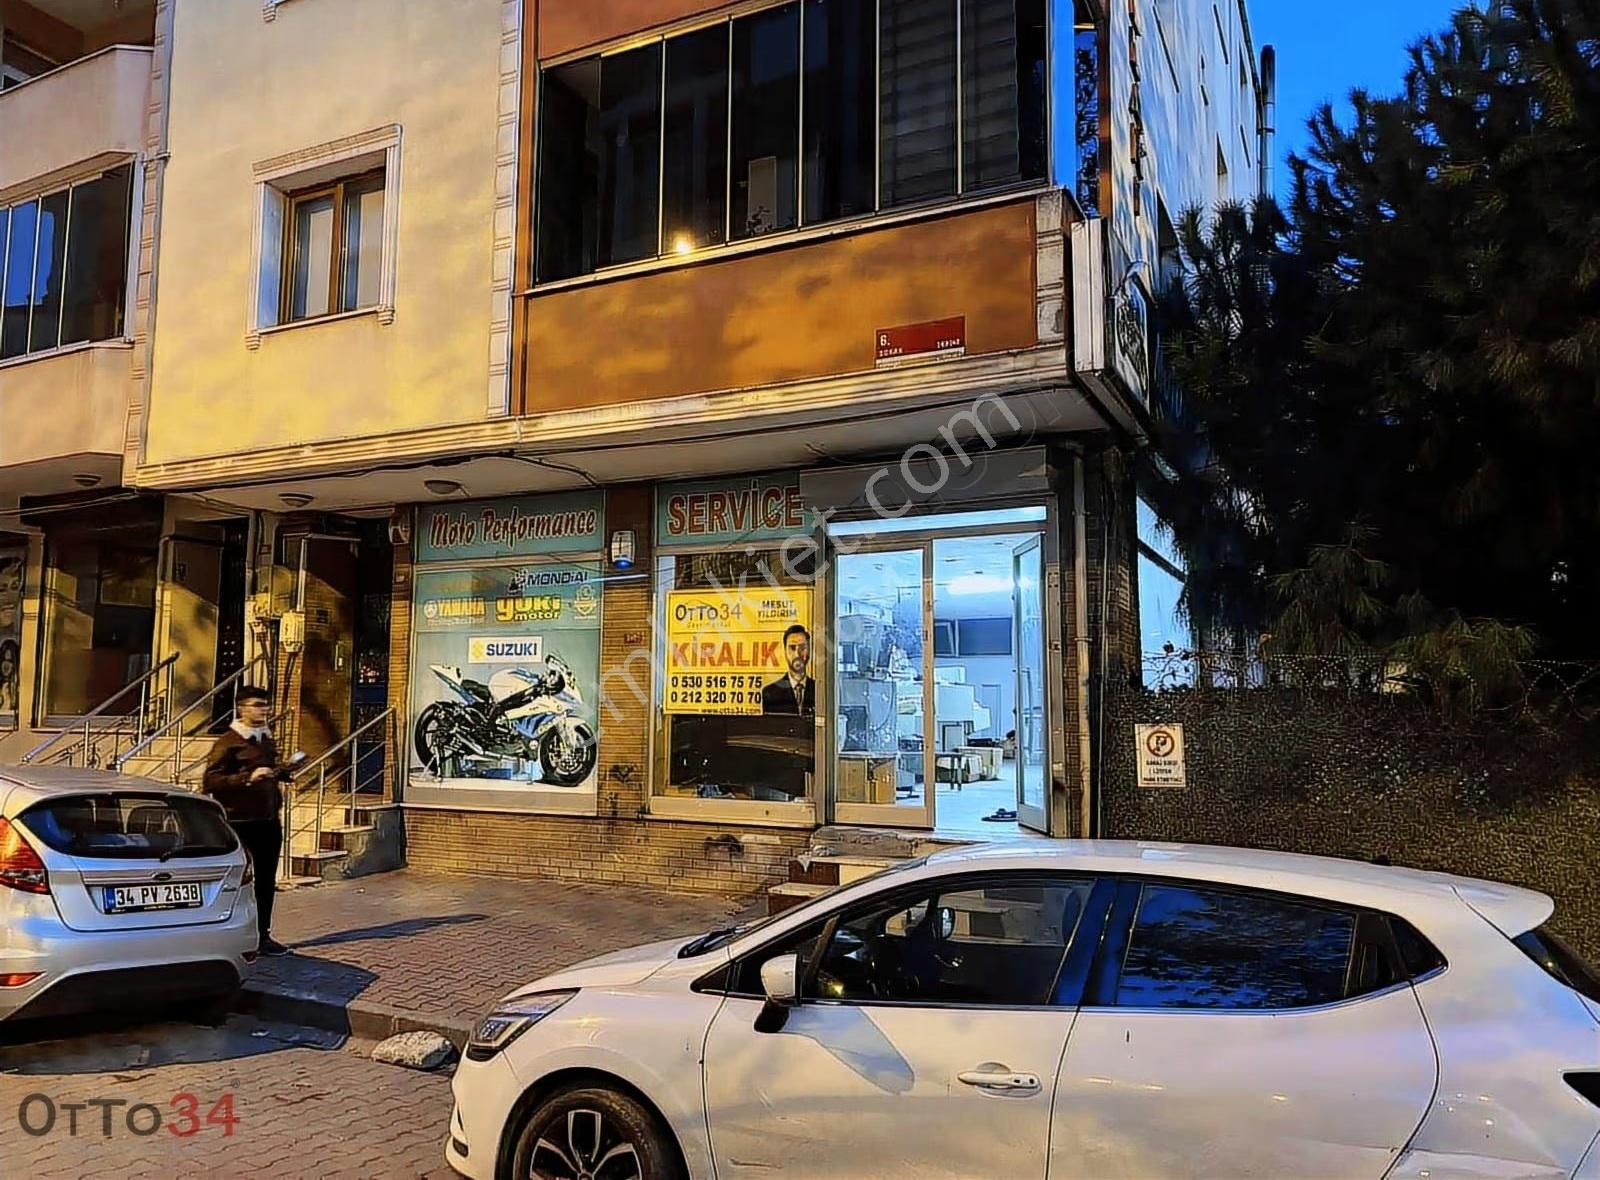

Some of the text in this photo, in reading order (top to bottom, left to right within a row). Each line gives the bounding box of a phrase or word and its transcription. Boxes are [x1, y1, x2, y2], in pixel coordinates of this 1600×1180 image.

[429, 506, 598, 549] Moto Performance
[486, 642, 537, 656] SUZUKI
[672, 637, 780, 667] KİRALIK
[671, 676, 762, 688] 0 530 516 75 75
[671, 691, 762, 703] 0 212 320 70 70
[116, 889, 135, 905] 34
[141, 886, 158, 902] PV
